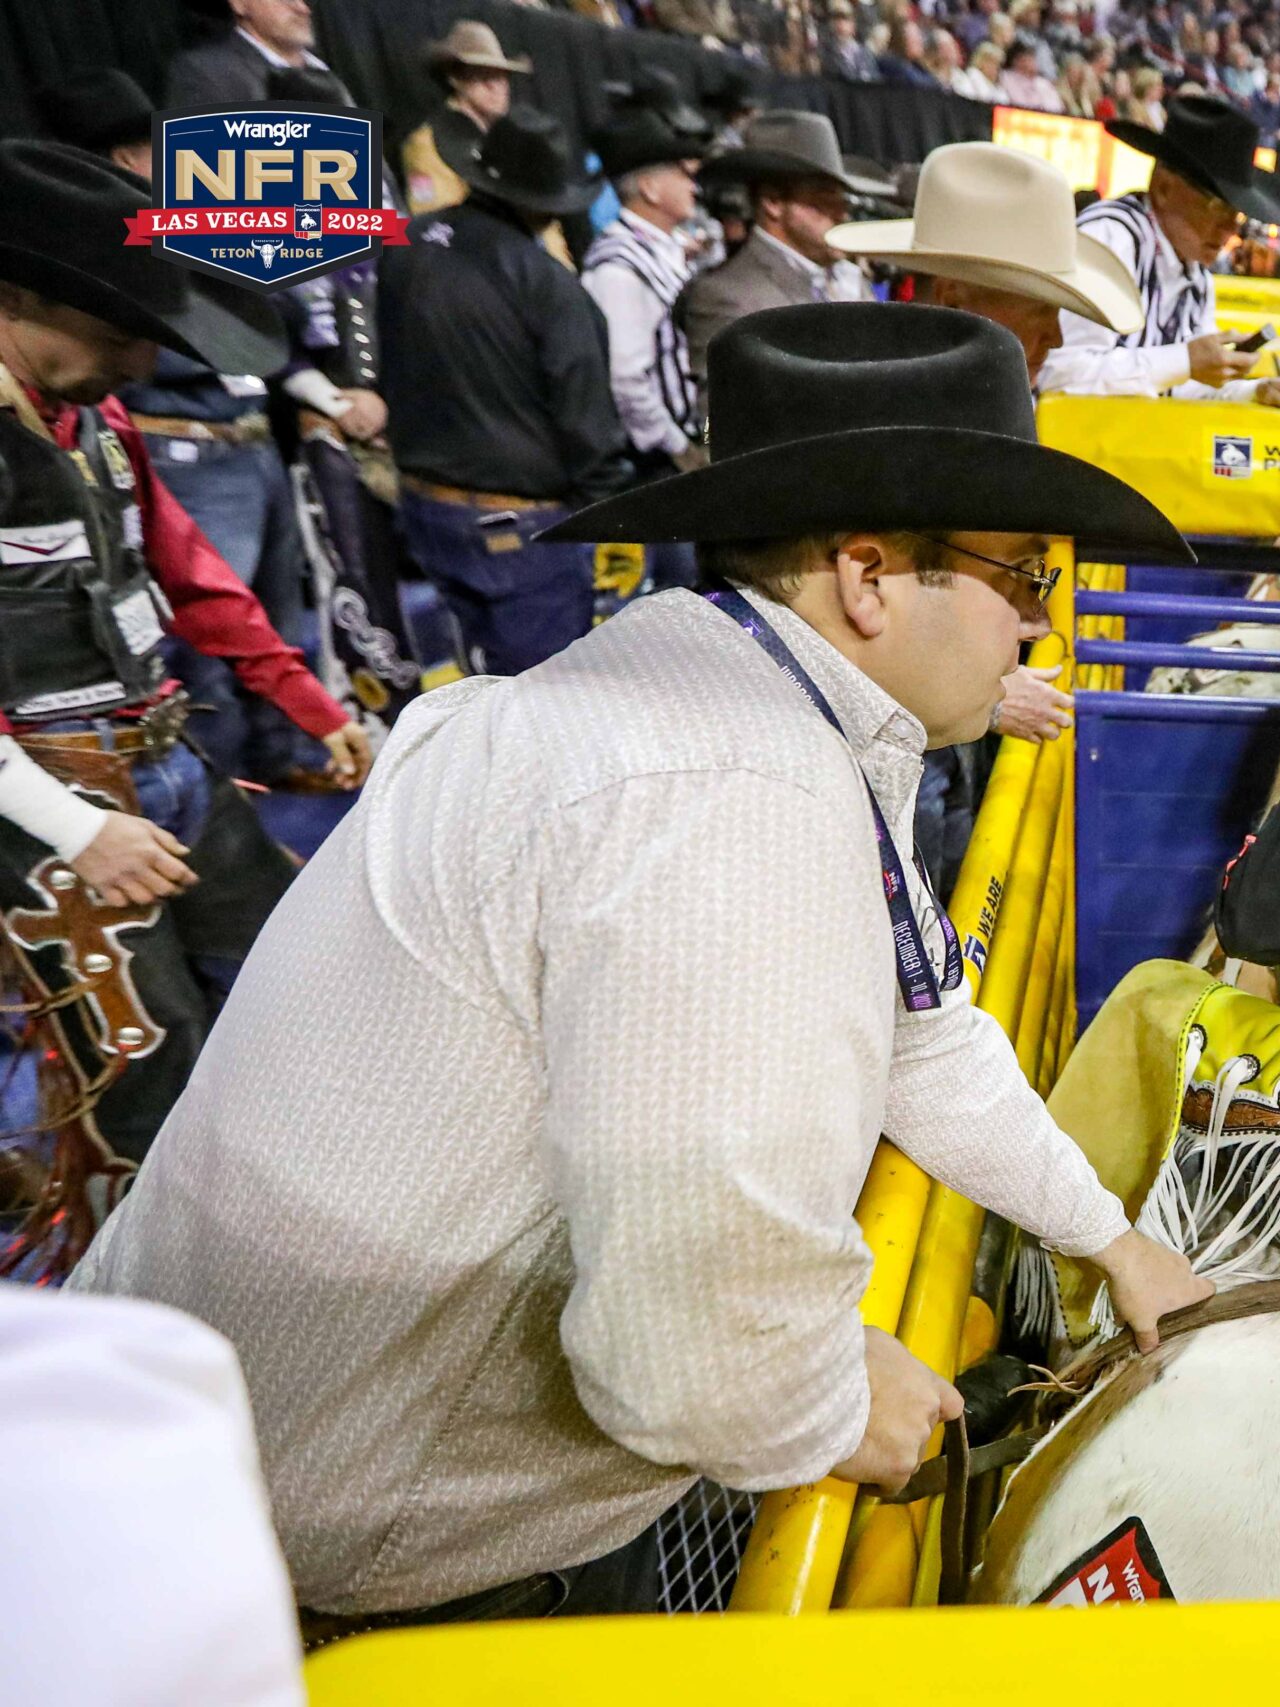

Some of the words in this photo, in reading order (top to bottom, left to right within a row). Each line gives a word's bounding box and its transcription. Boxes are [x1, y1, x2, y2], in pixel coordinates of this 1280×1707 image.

[977, 906, 994, 937] WE
[989, 875, 1004, 913] ARE
[892, 919, 921, 971] DECEMBER
